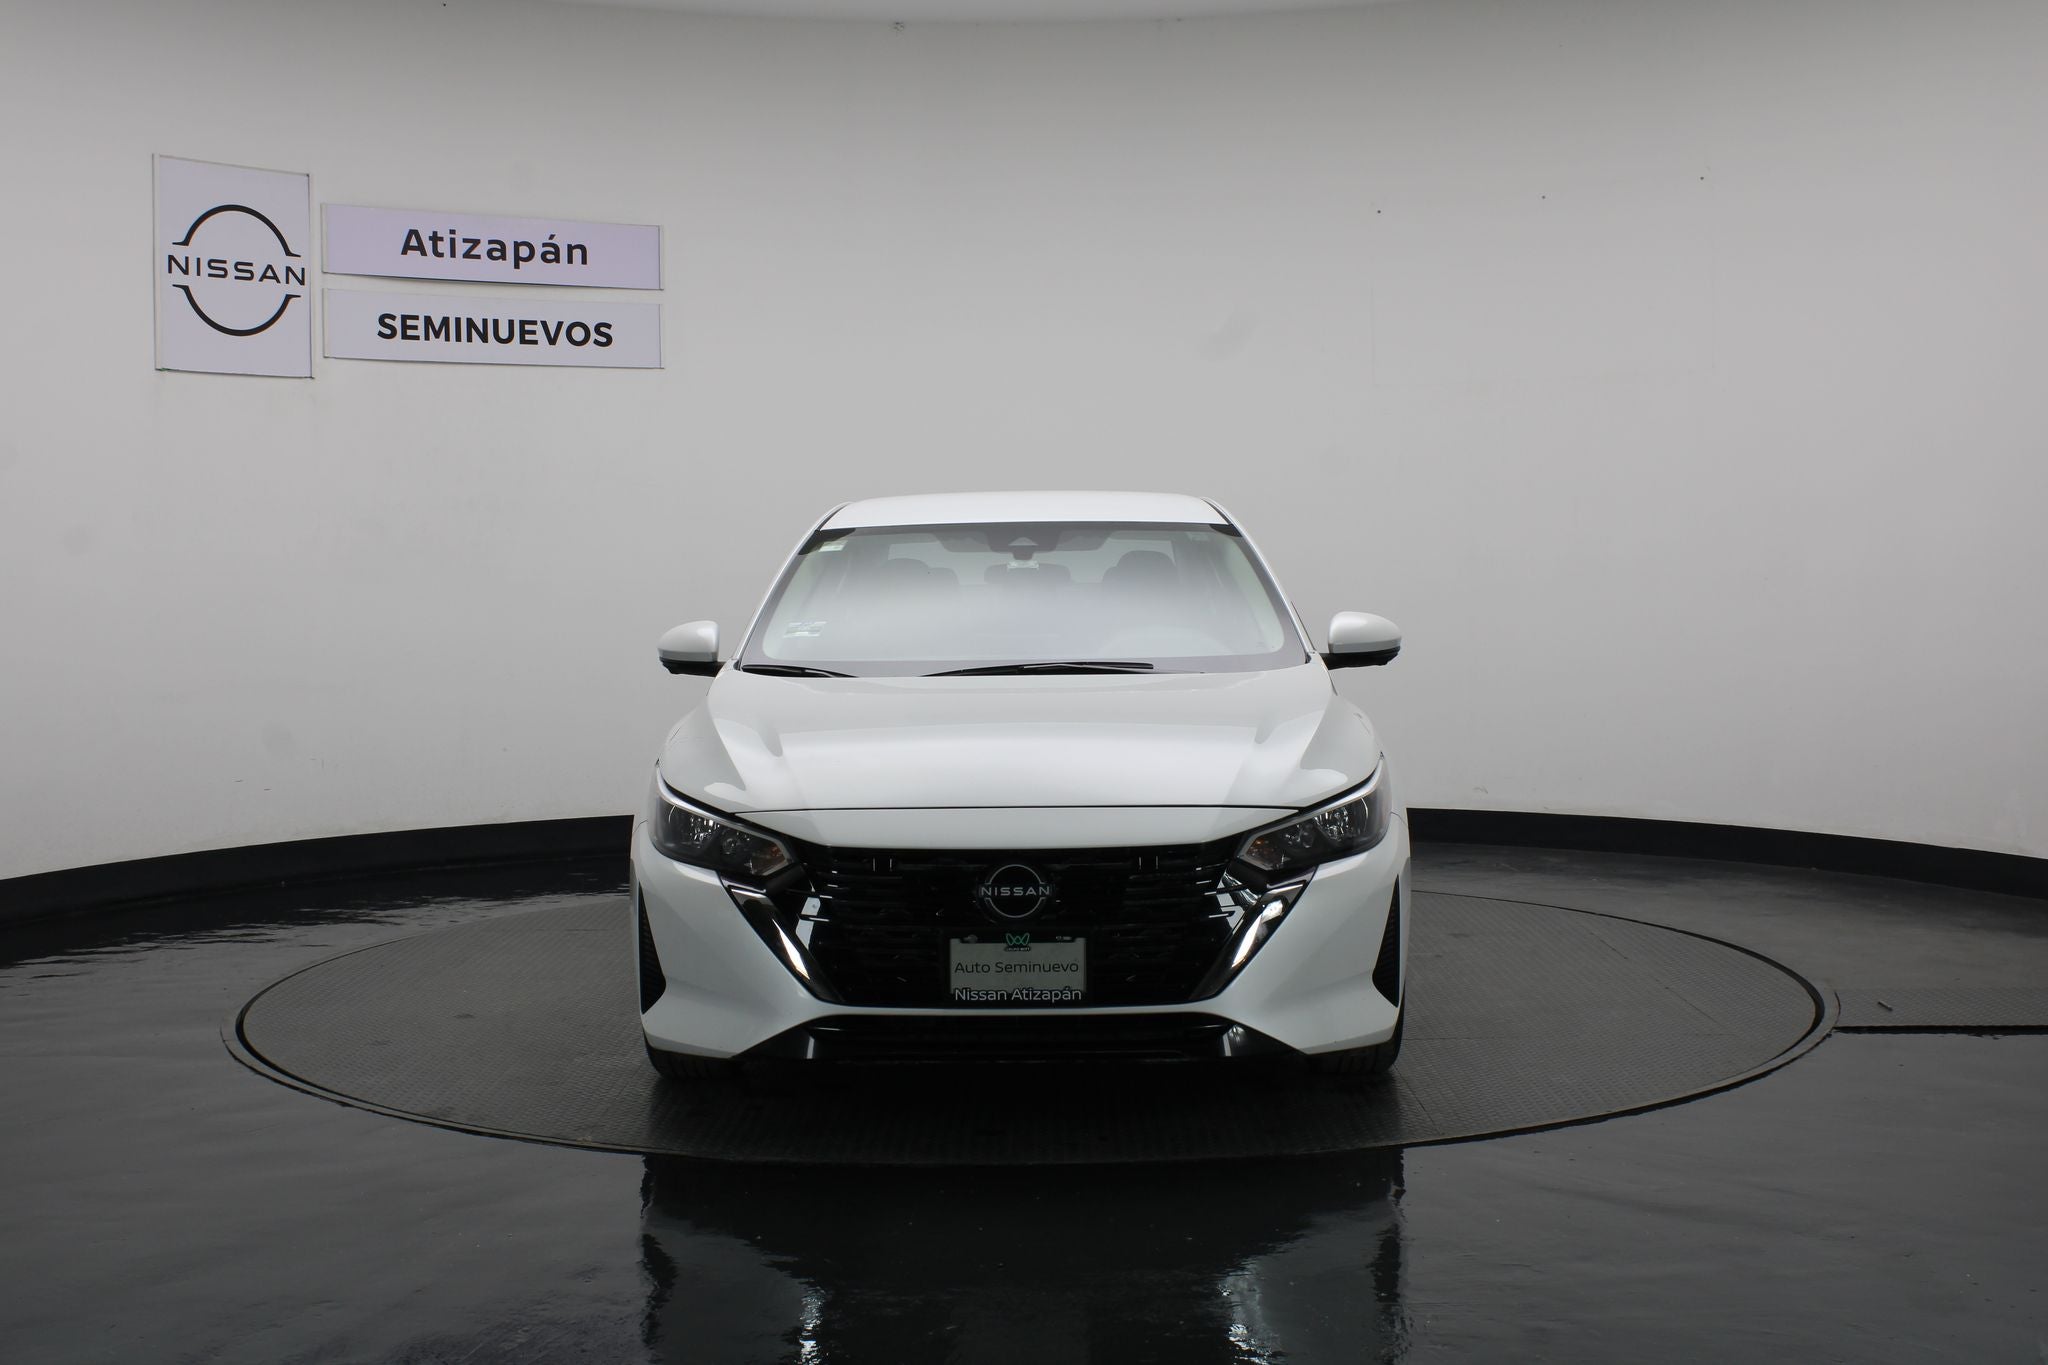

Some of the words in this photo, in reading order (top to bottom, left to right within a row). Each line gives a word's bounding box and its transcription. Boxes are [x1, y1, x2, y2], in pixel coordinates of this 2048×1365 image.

[401, 228, 589, 270] Atizapán
[167, 254, 306, 286] NISSAN
[377, 312, 614, 348] SEMINUEVOS
[981, 886, 1050, 896] NISSAN
[954, 962, 991, 974] Auto
[995, 962, 1079, 974] Seminuevo
[955, 988, 1007, 1001] Nissan
[1011, 985, 1082, 1003] Atizapán
